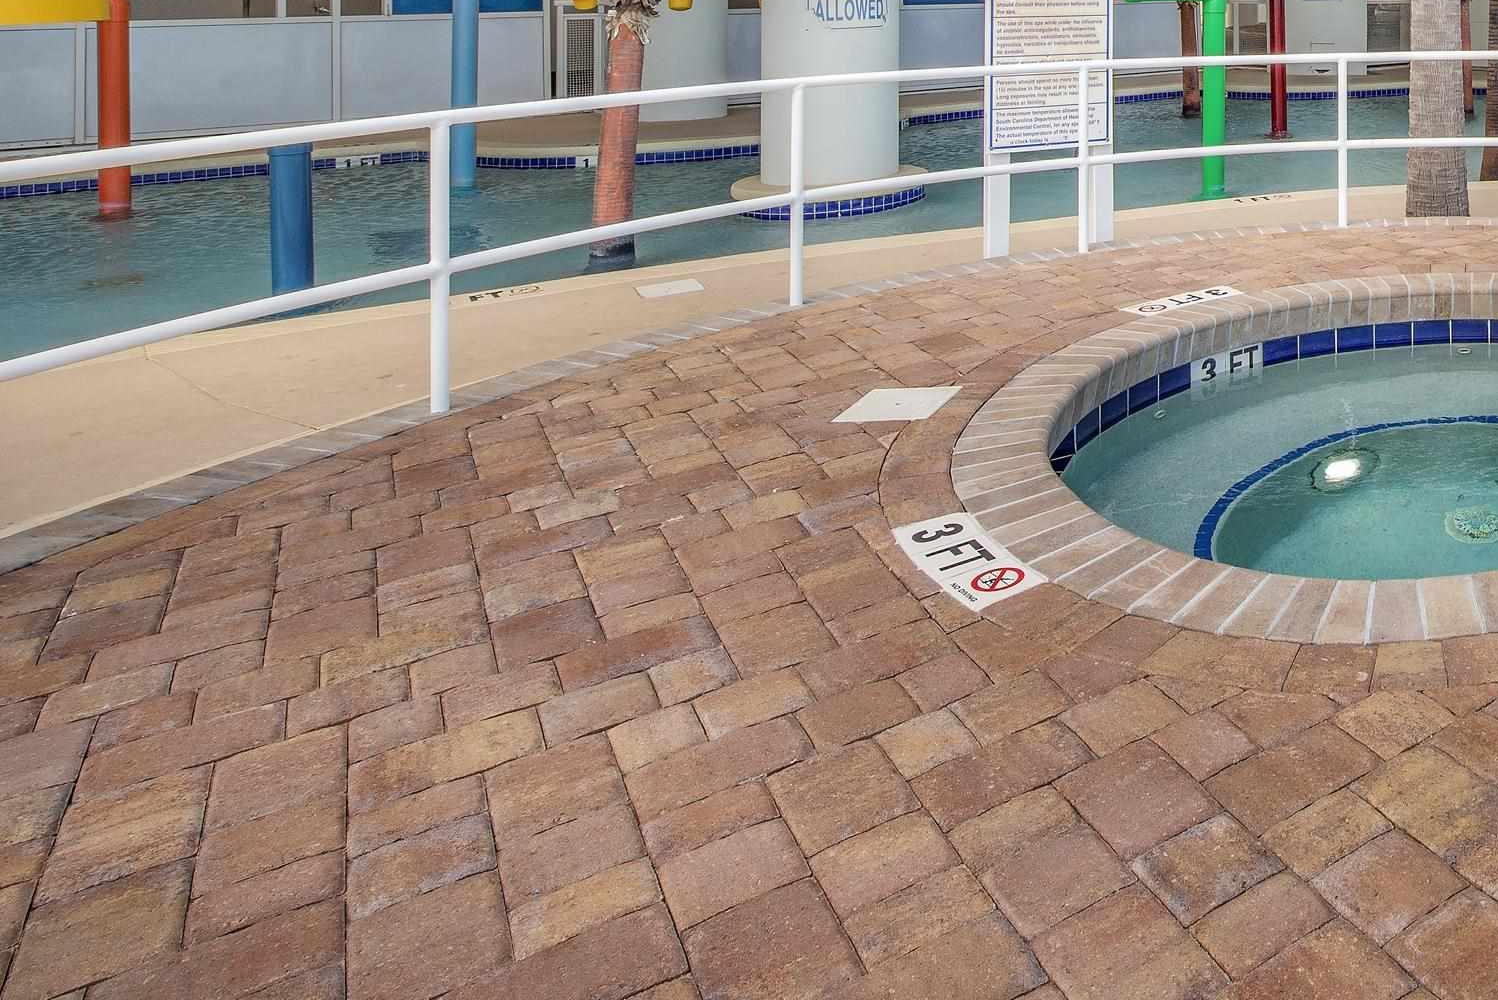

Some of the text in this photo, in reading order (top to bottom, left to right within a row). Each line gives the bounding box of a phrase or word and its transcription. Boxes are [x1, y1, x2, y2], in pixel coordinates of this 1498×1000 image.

[344, 156, 379, 168] 1 FT
[583, 158, 589, 168] 1
[469, 290, 503, 302] FT
[1168, 294, 1203, 305] FT
[1201, 345, 1259, 382] 3 FT
[911, 523, 996, 572] 3 FT
[959, 588, 978, 602] DIVING
